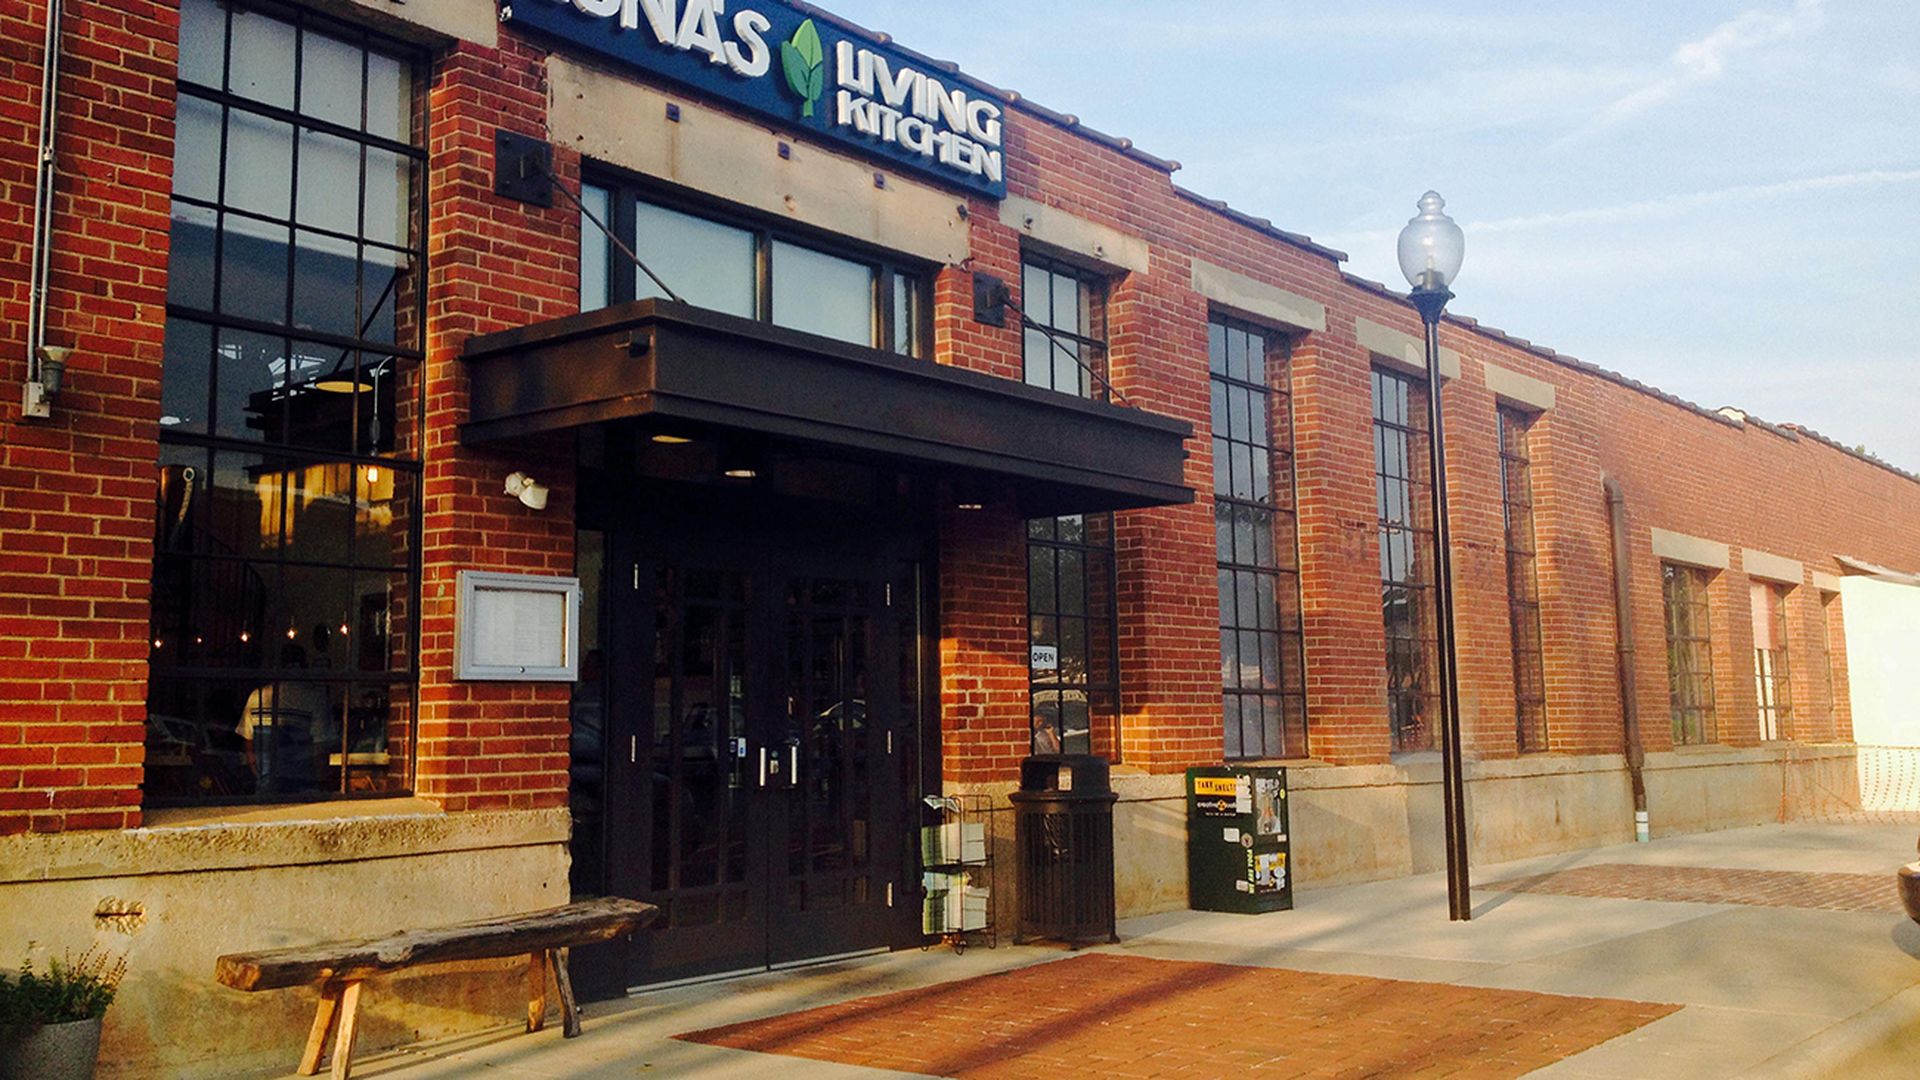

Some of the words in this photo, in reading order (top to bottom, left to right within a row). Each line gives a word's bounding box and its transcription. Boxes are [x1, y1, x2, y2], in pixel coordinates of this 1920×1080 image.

[554, 0, 771, 77] NA'S
[836, 39, 1001, 146] LIVING
[836, 89, 1001, 182] KITCHEN
[1032, 652, 1054, 663] OPEN
